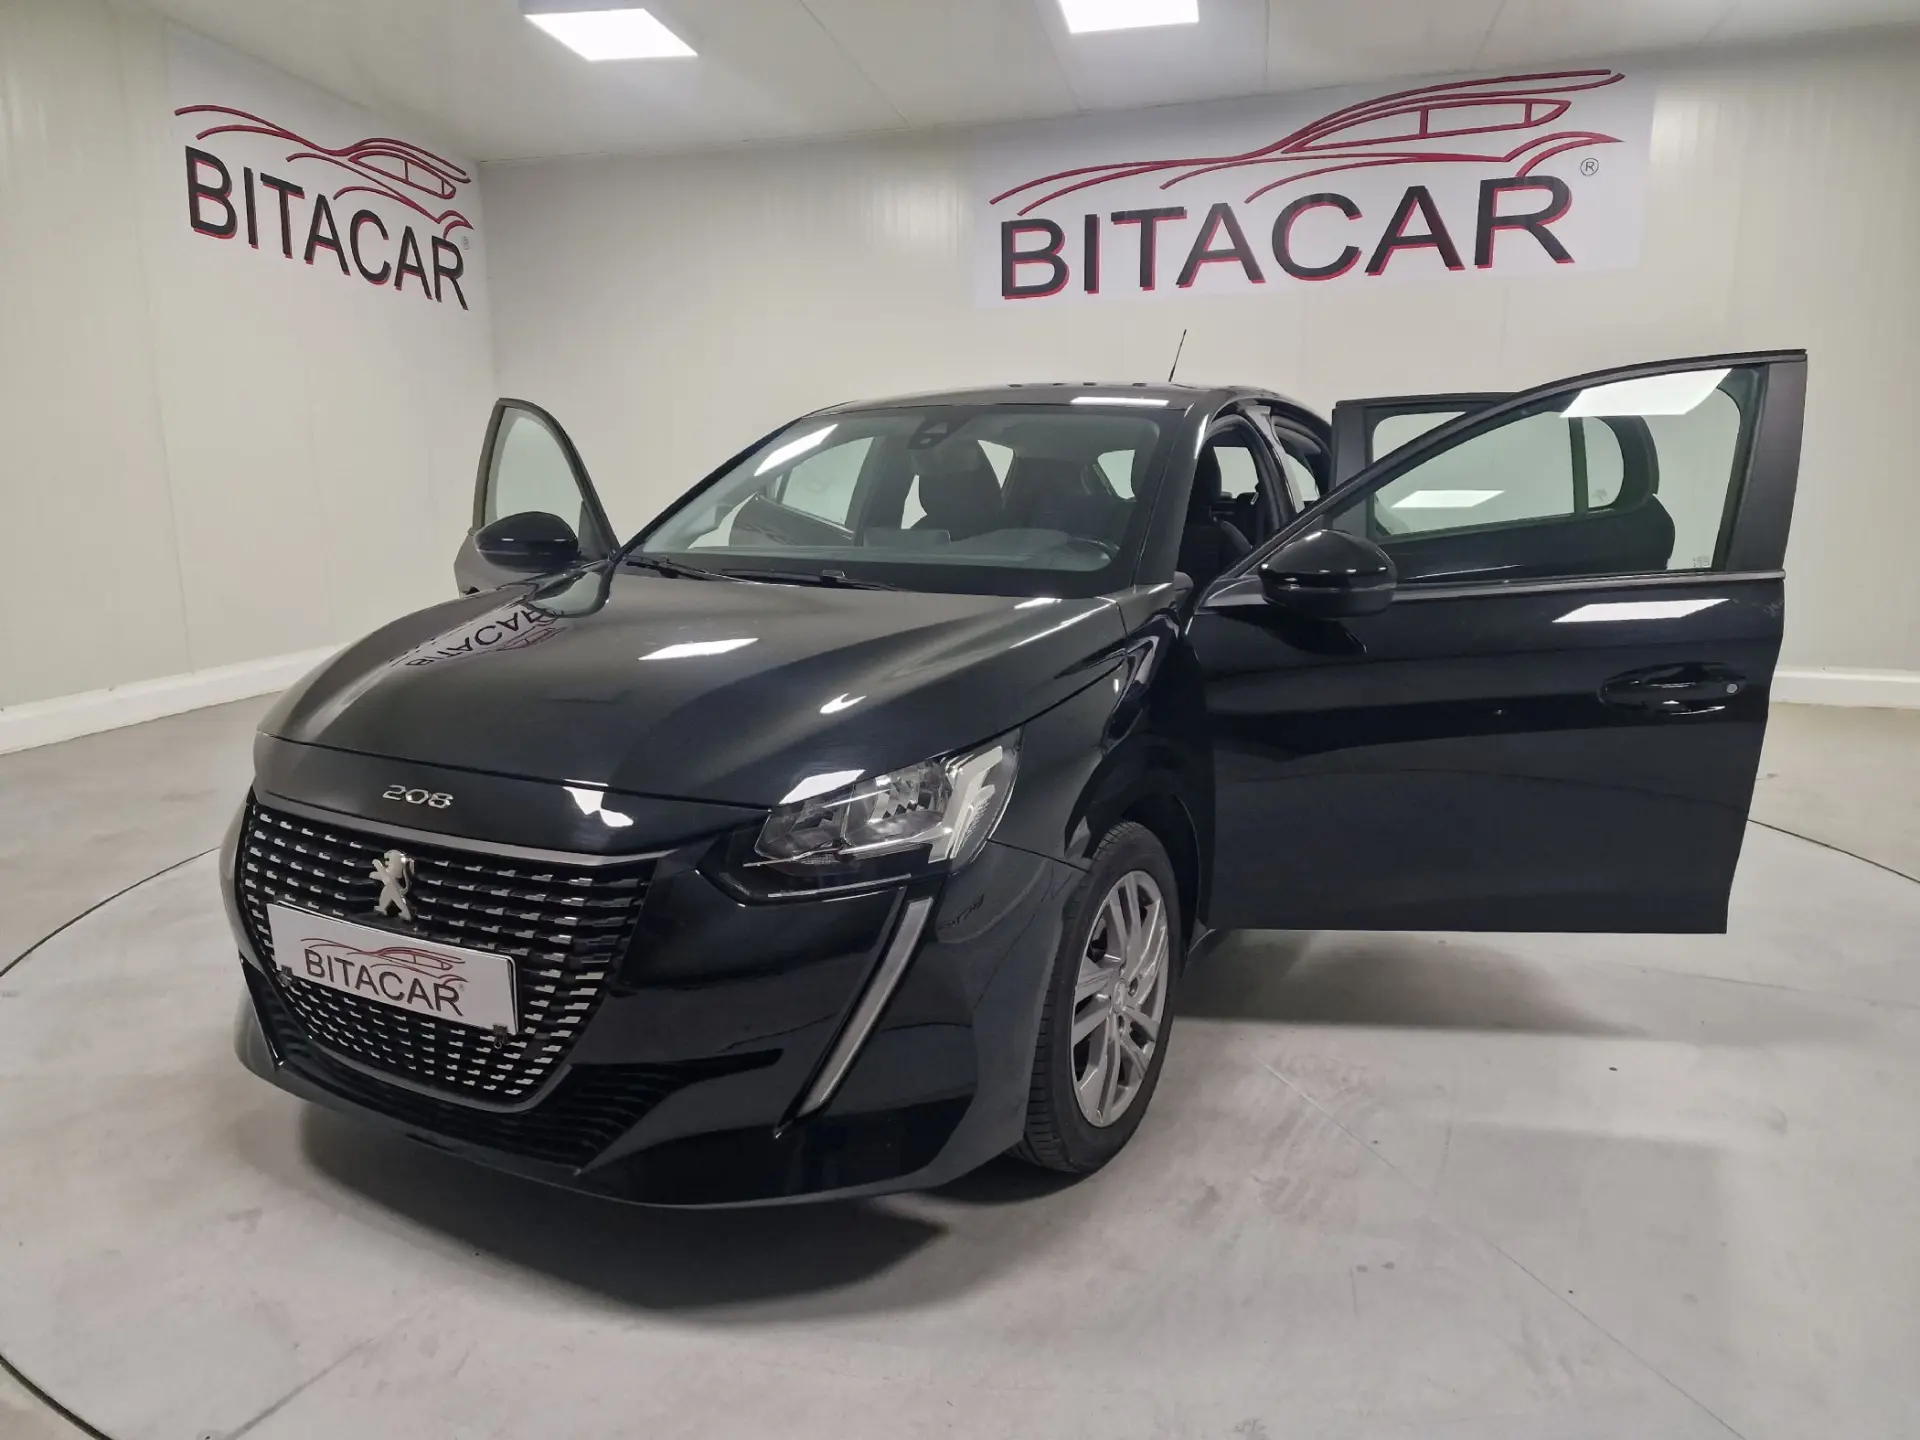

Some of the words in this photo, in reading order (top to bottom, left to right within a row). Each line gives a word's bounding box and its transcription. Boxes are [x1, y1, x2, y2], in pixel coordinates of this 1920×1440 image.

[185, 145, 469, 310] BITACAR
[1001, 175, 1575, 300] BITACAR
[382, 784, 454, 809] 208
[304, 948, 463, 1017] BITACAR
